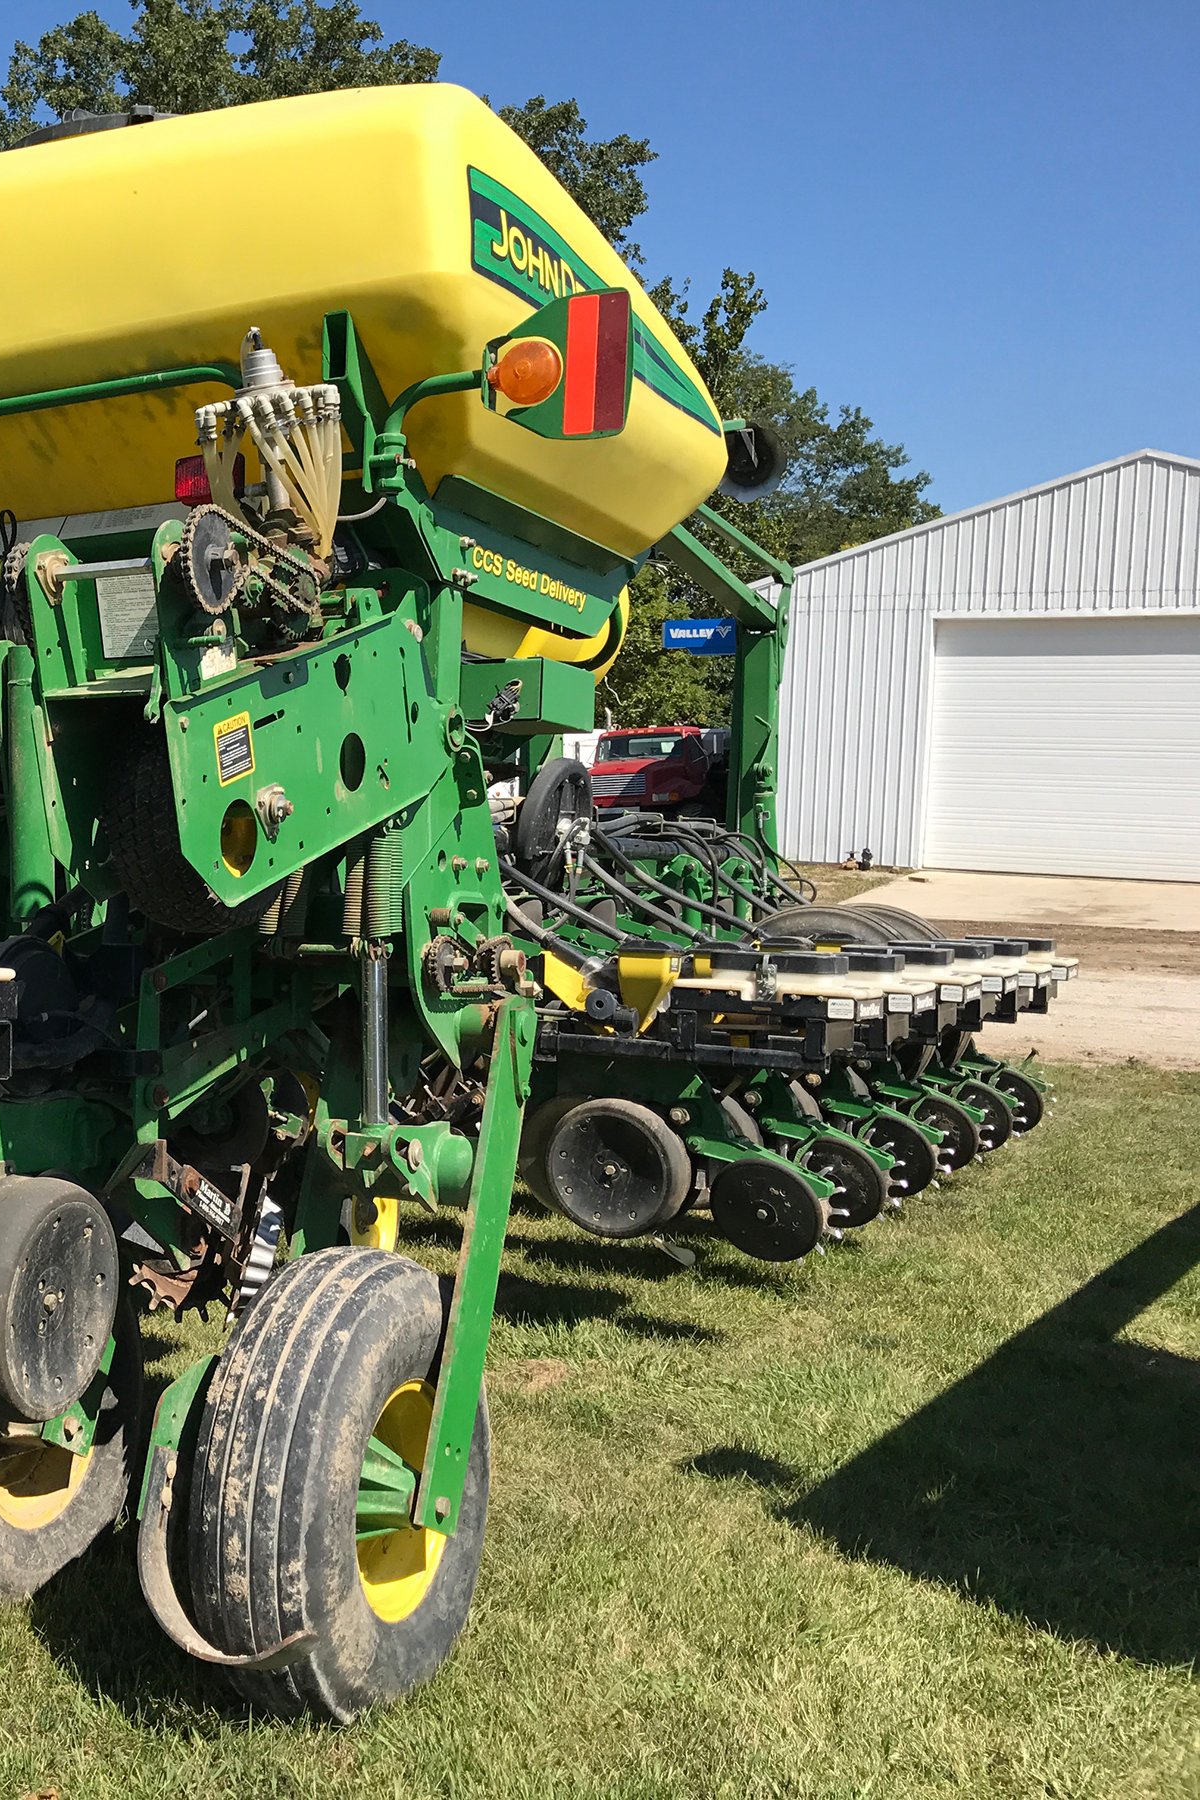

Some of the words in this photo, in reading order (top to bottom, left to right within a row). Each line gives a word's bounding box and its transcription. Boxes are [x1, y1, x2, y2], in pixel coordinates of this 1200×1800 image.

[492, 208, 559, 298] JOHN
[472, 545, 503, 577] CCS
[505, 559, 538, 591] Seed
[539, 573, 587, 614] Delivery
[669, 628, 715, 640] VALLEY
[200, 1180, 223, 1208] Martin
